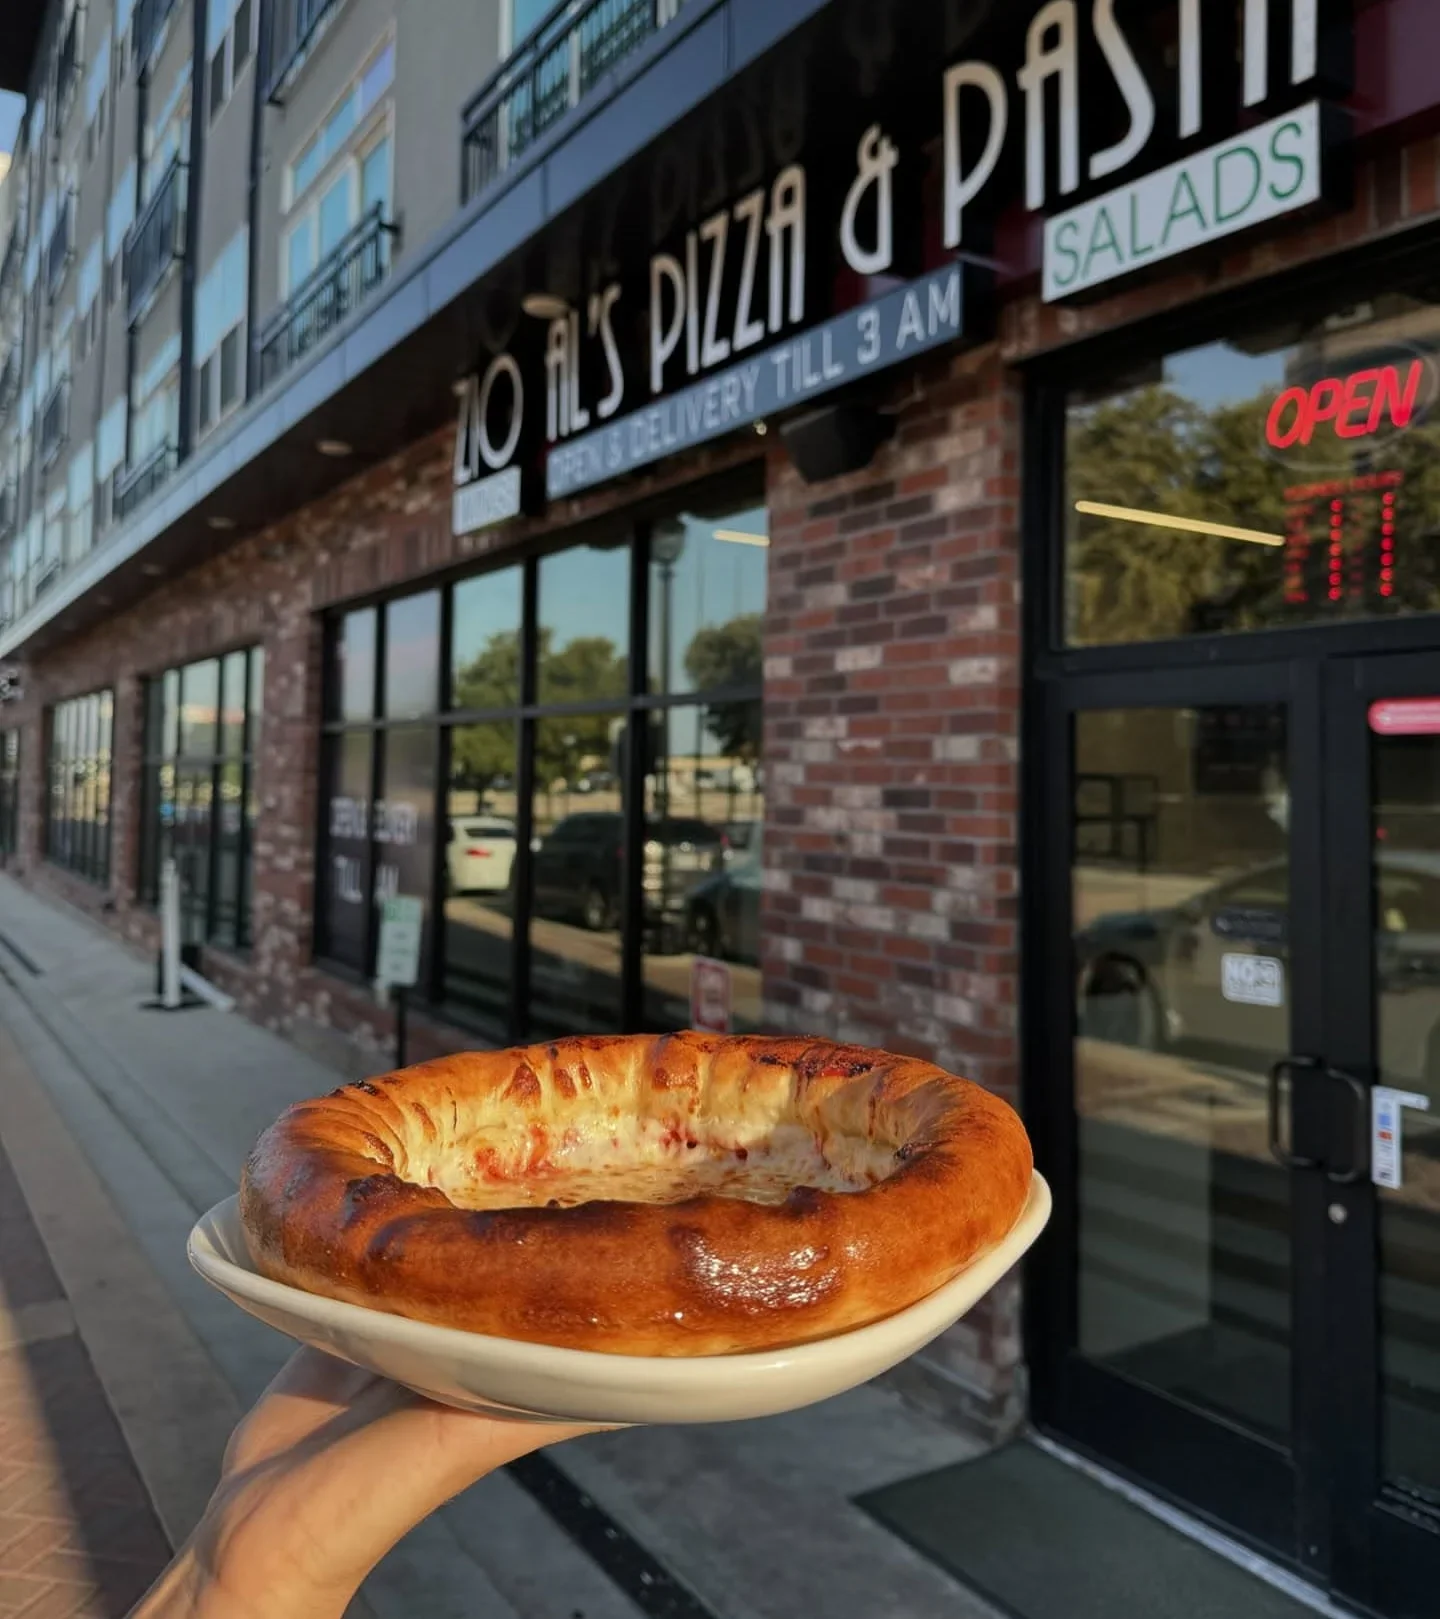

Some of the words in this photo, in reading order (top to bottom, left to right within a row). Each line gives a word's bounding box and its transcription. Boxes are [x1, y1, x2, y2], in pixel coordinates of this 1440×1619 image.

[1052, 121, 1306, 288] SALADS
[452, 354, 523, 485] ZIO
[545, 282, 625, 442] AL'S
[649, 165, 806, 394] PIZZA
[840, 122, 899, 275] &
[629, 363, 761, 460] DELIVERY
[770, 328, 845, 399] TILL
[857, 304, 881, 366] 3
[896, 267, 961, 352] AM
[1265, 358, 1424, 449] OPEN
